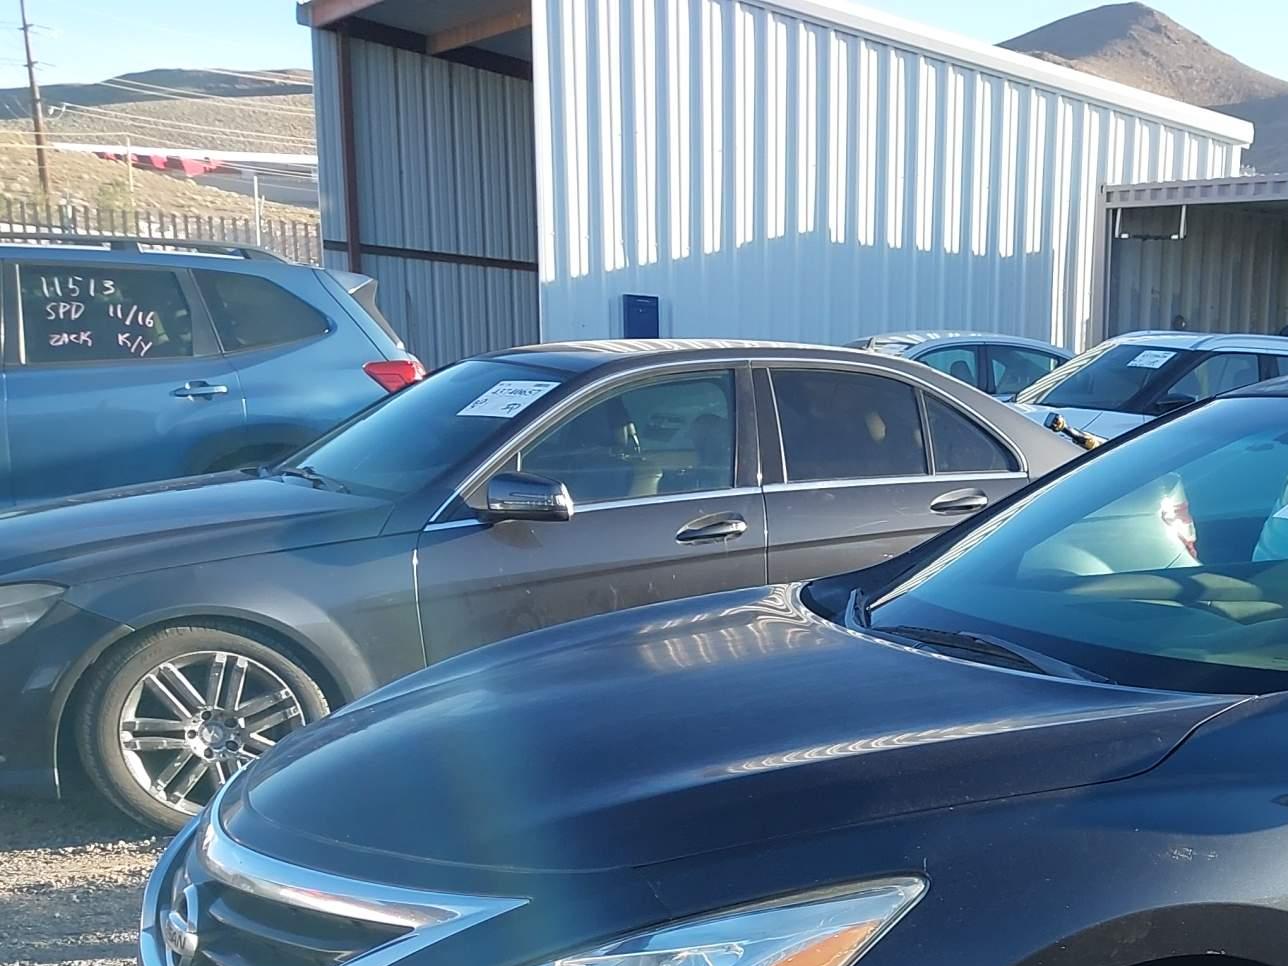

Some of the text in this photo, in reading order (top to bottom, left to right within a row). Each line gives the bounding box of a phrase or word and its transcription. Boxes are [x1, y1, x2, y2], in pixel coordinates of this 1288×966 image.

[40, 276, 116, 298] 11513
[46, 302, 155, 328] SPD 11/16
[49, 331, 153, 357] ZACK K/Y
